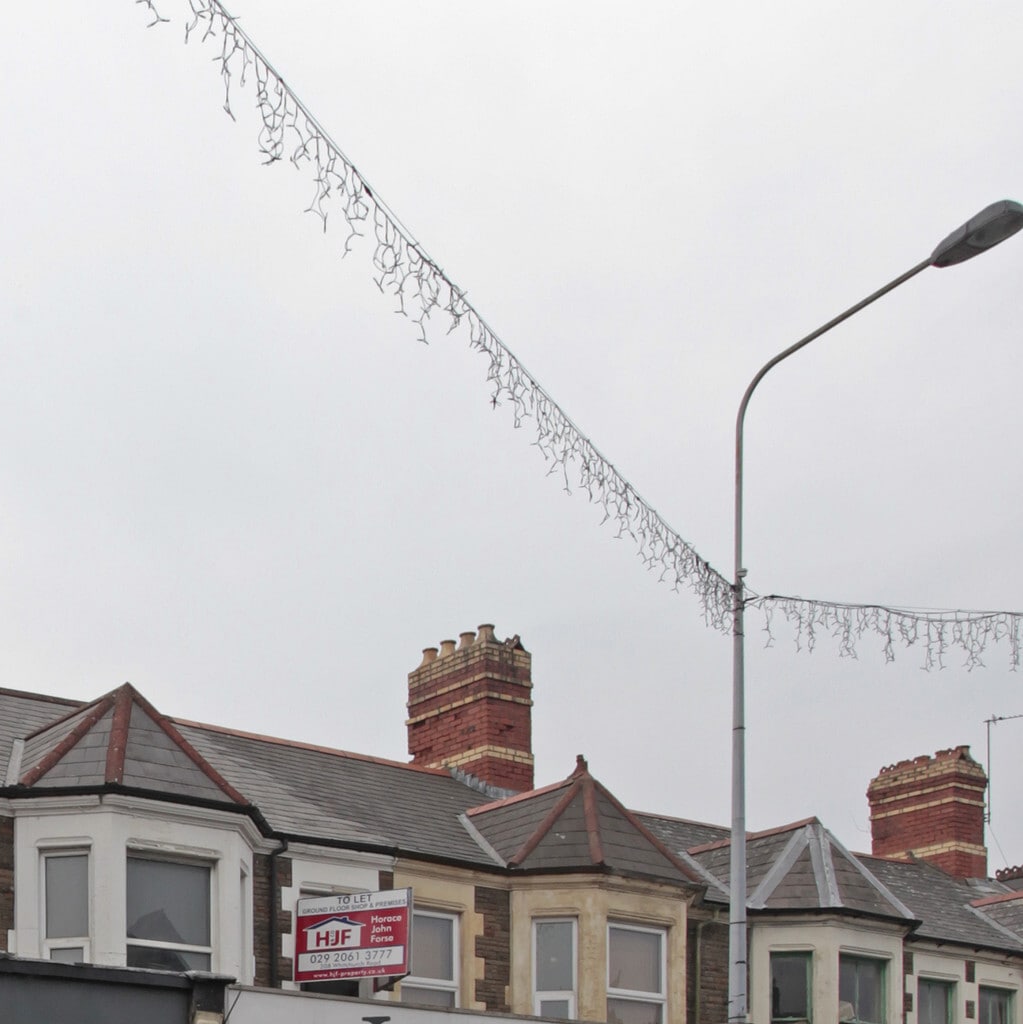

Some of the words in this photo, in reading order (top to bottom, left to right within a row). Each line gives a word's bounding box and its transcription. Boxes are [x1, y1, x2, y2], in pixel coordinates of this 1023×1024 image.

[337, 896, 351, 905] TO
[354, 893, 373, 903] LET
[302, 906, 328, 914] GROUND
[329, 904, 351, 912] FLOOR
[351, 902, 368, 910] SHOP
[375, 898, 406, 908] PREMISES
[371, 915, 402, 924] Horace
[371, 923, 392, 934] John
[315, 928, 352, 948] HJF
[370, 934, 394, 943] Forse
[310, 954, 330, 964] 029
[334, 951, 360, 963] 2061
[364, 949, 393, 960] 3777
